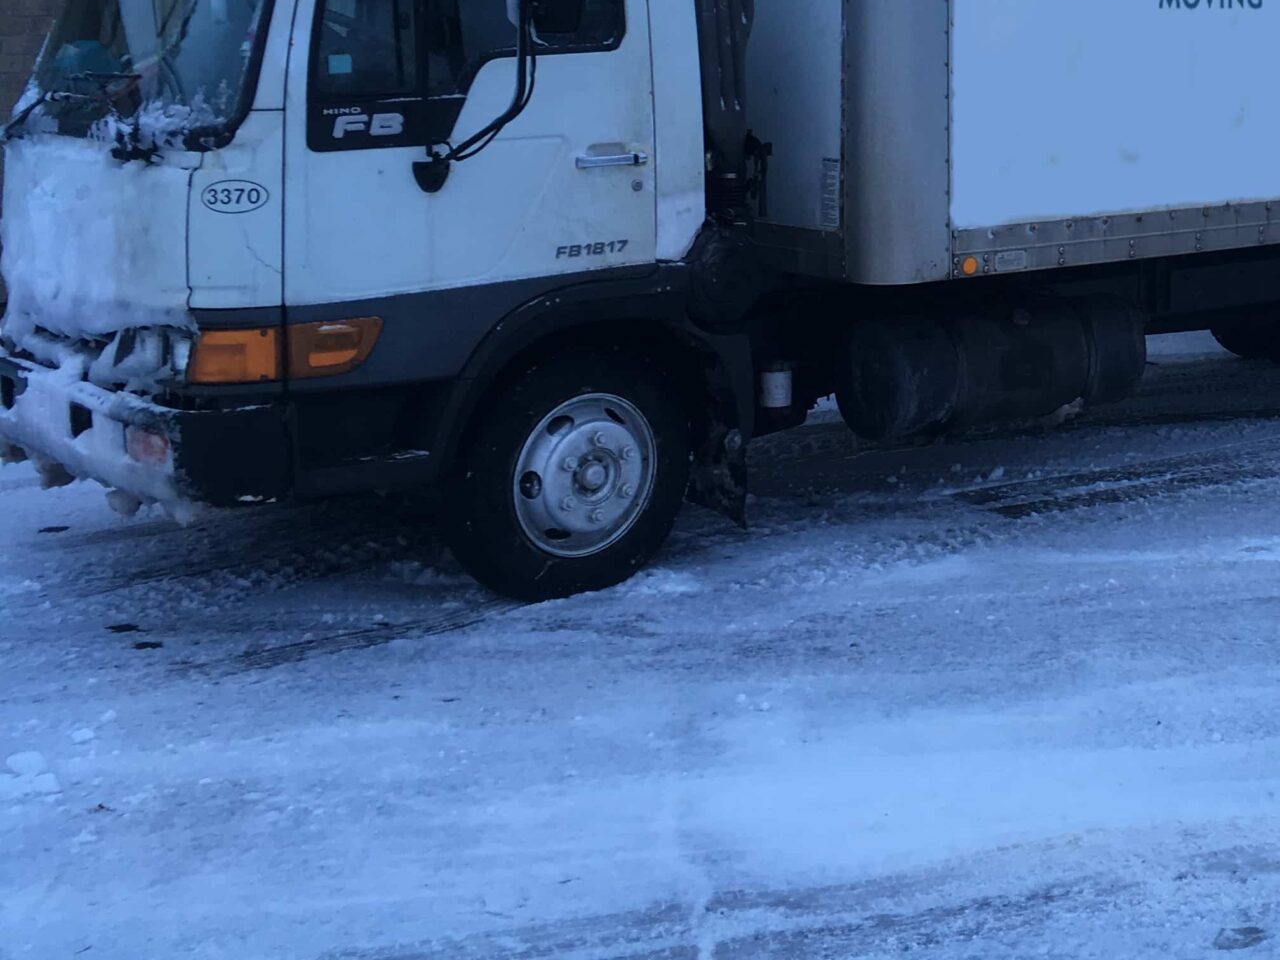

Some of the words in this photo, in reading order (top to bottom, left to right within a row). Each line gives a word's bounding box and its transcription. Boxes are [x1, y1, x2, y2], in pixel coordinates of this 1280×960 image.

[322, 106, 361, 115] HINO
[332, 113, 404, 138] FB
[207, 188, 260, 205] 3370
[555, 239, 629, 259] FB1817
